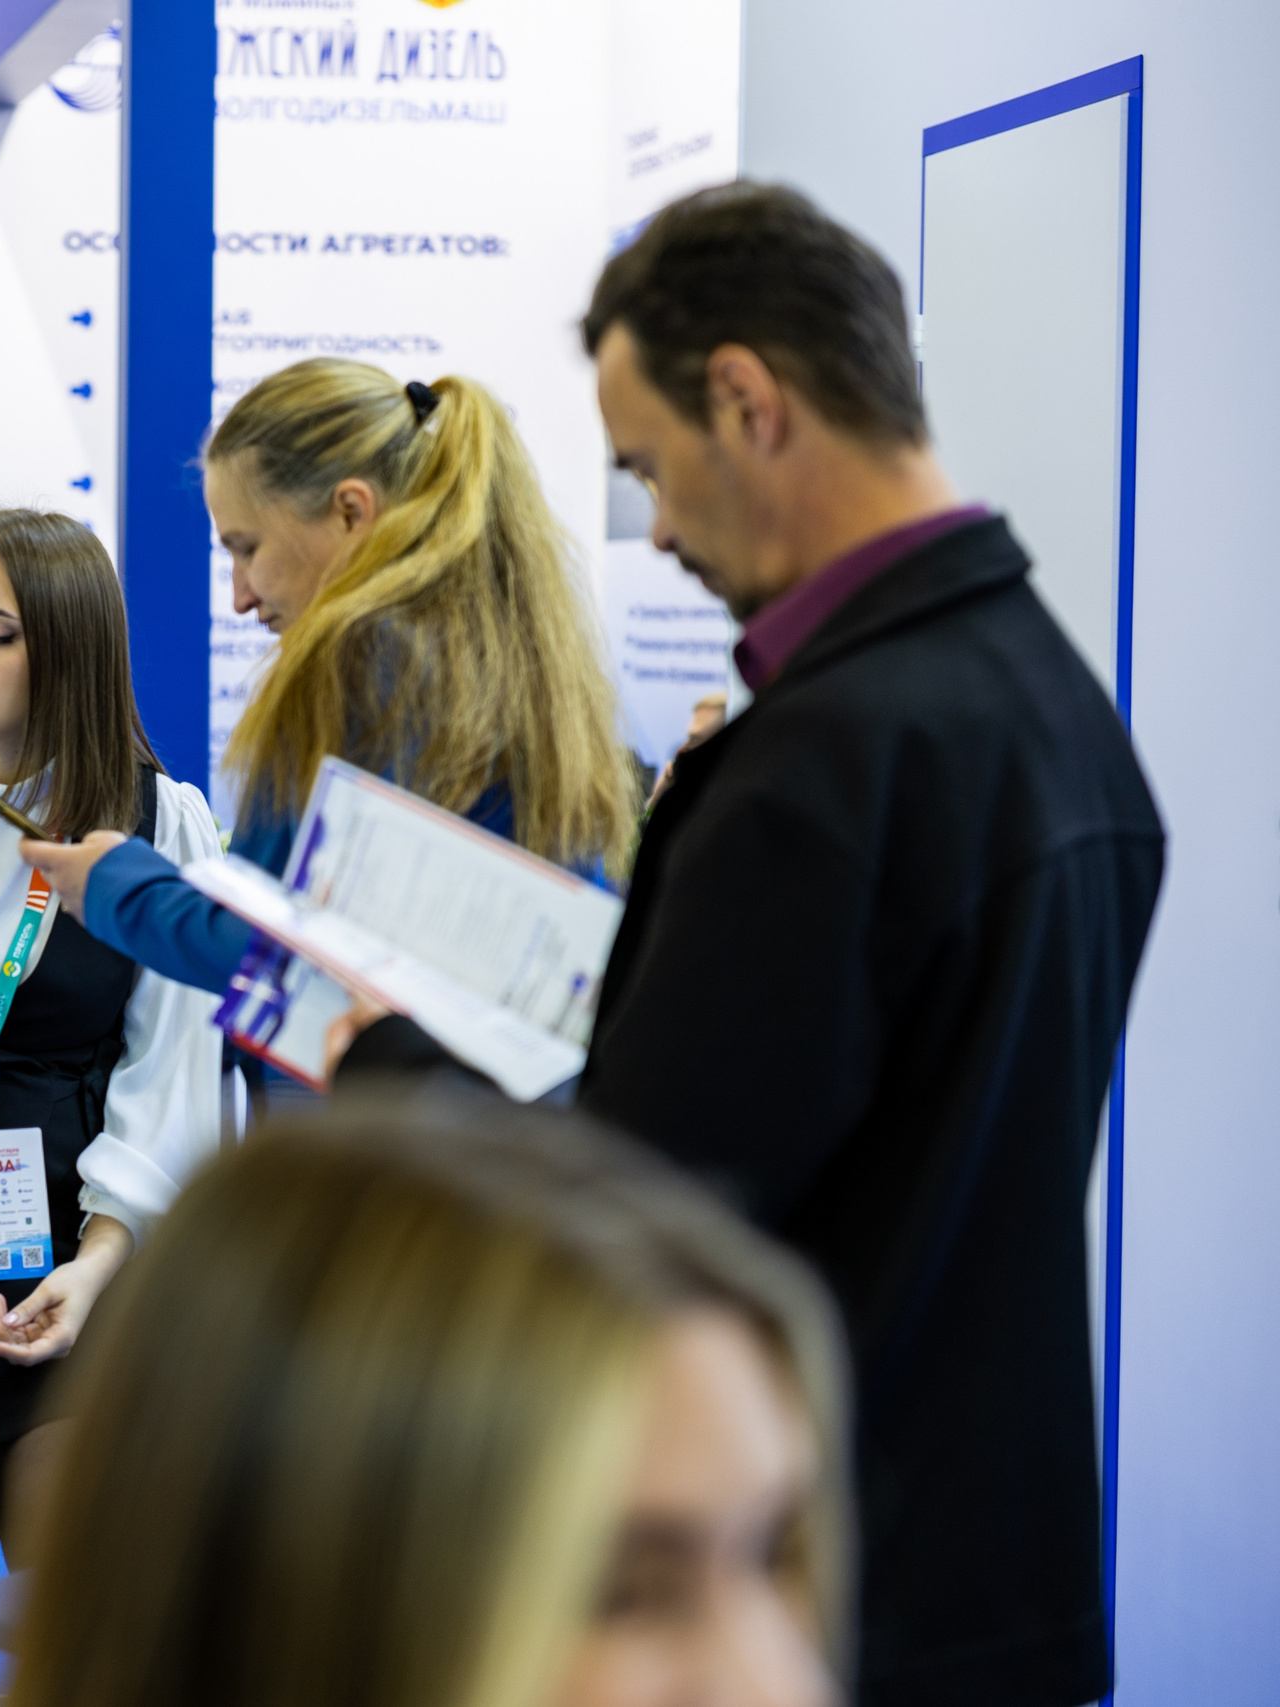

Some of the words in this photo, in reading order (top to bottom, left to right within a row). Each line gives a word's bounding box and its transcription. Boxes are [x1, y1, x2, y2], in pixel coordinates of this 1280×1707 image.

[223, 18, 357, 78] ЖСКИЙ
[375, 28, 506, 84] ДИЗЕЛЬ
[217, 97, 505, 125] ОЛГОДИЗЕЛЬМАШ
[321, 234, 509, 257] АГРЕГАТОВ:
[213, 334, 442, 354] ТОПРИГОДНОСТЬ
